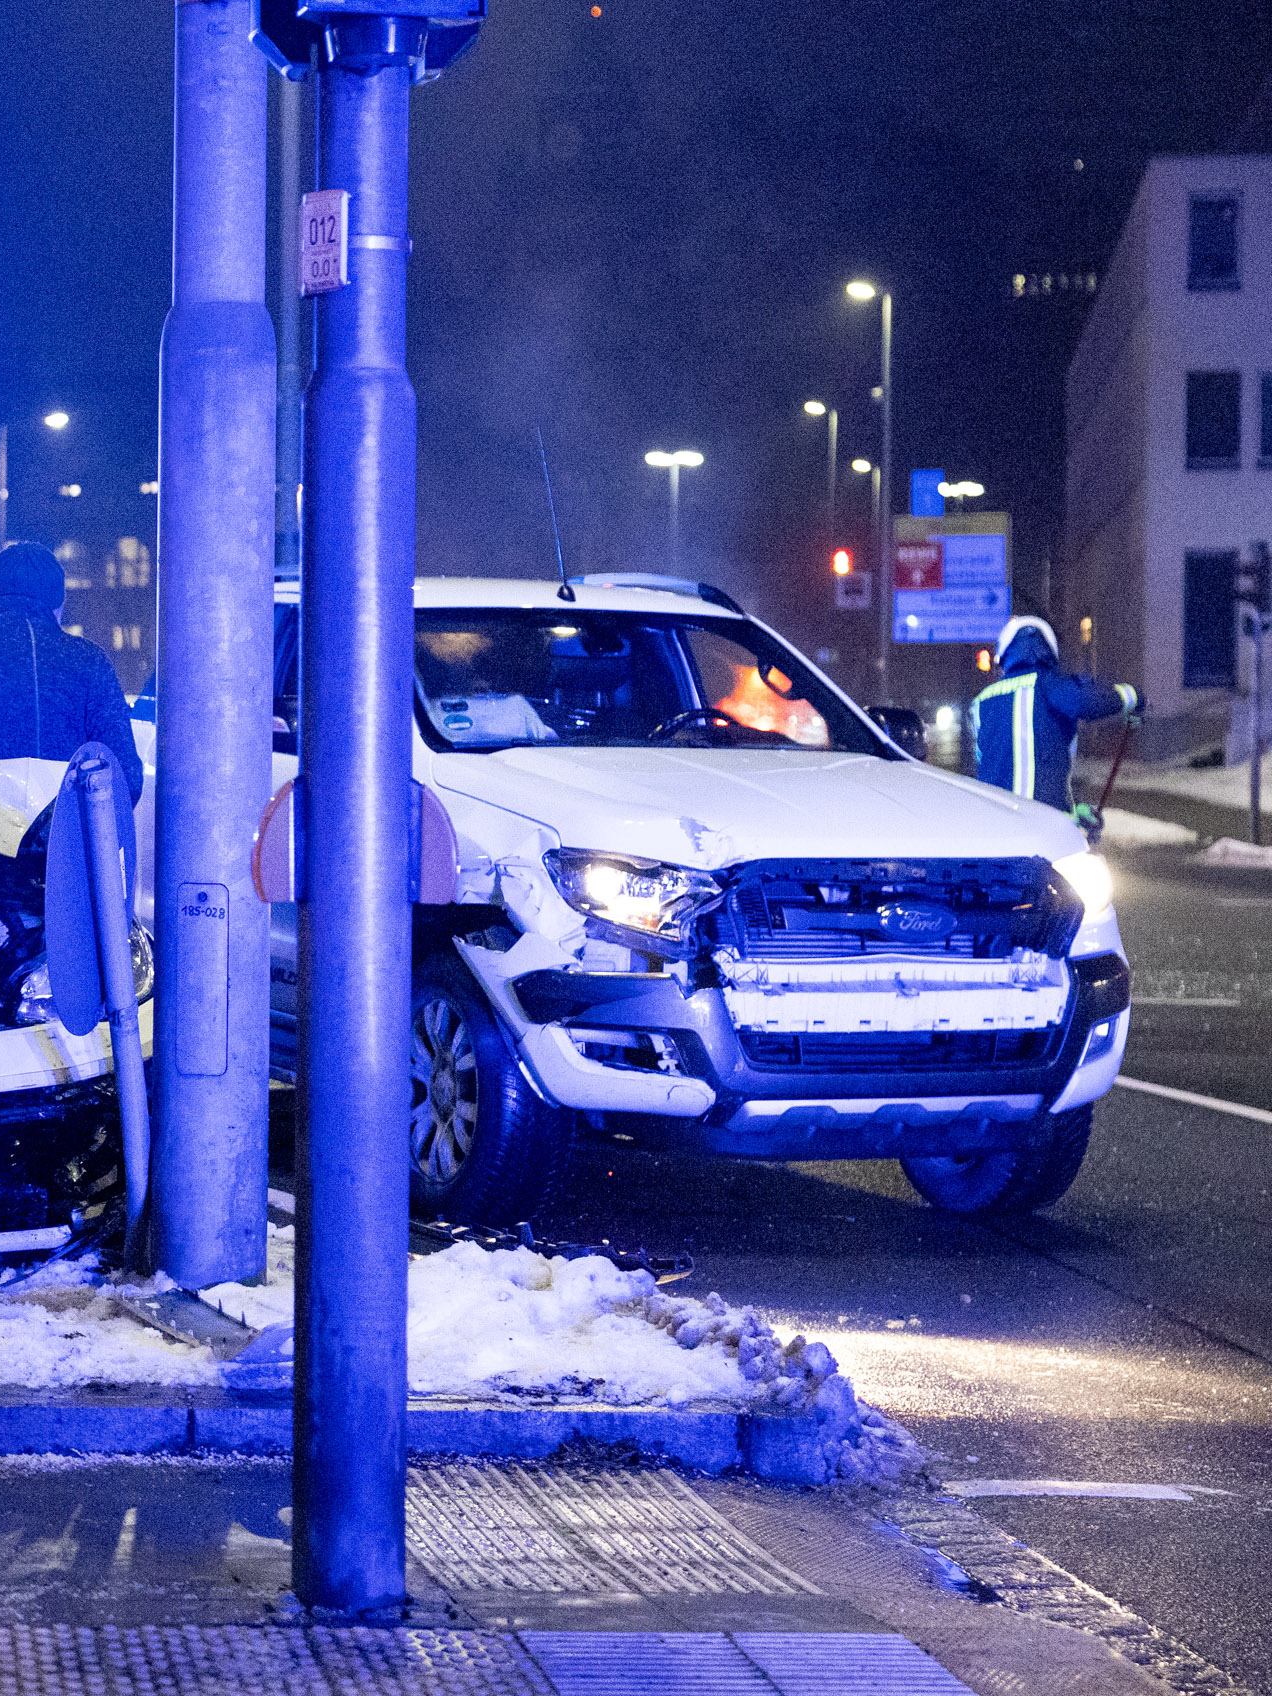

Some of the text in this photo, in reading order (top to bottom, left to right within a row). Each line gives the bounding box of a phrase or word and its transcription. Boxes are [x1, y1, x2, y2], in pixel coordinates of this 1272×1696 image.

[309, 215, 336, 246] 012
[181, 905, 226, 920] 185-028
[899, 910, 942, 932] Ford
